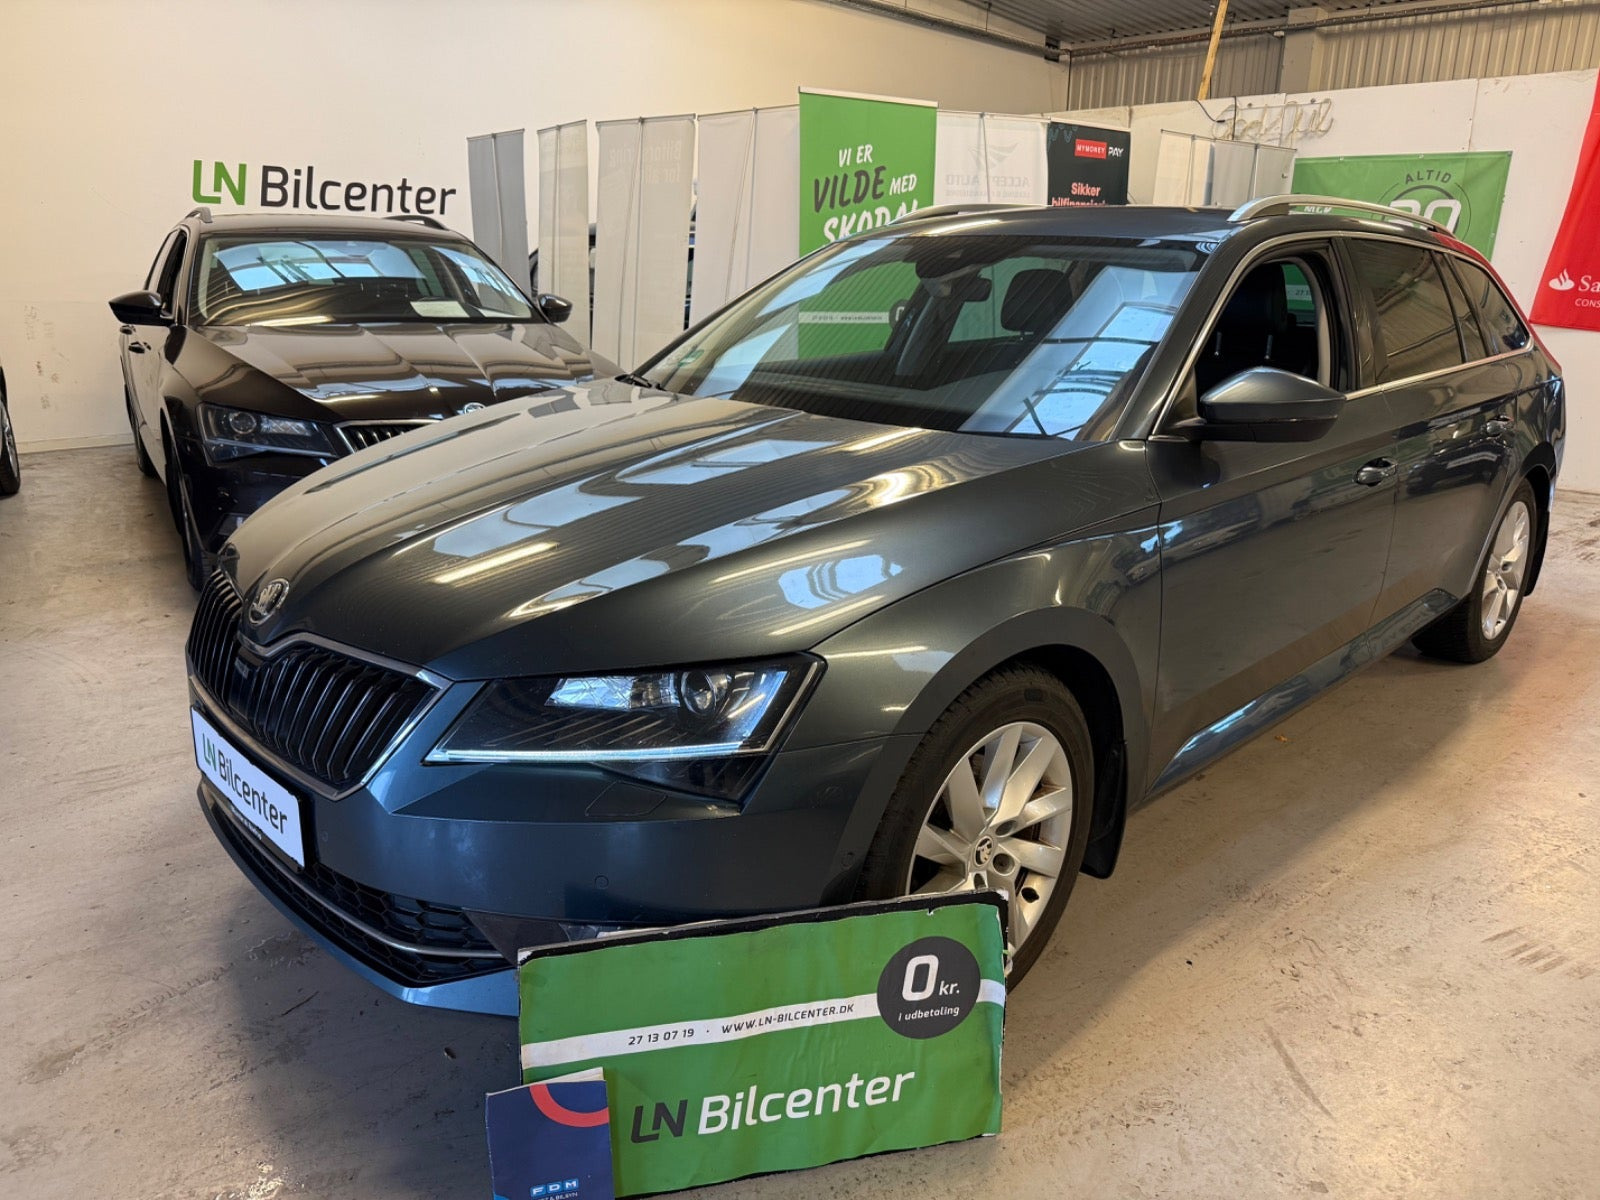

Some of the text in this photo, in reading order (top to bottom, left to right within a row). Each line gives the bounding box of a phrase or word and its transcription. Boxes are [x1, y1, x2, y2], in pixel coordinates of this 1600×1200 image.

[838, 143, 873, 168] VI ER
[1107, 146, 1125, 158] PAY
[192, 159, 457, 216] LN Bilcenter
[814, 165, 918, 213] VILDE MED
[1071, 181, 1101, 197] Sikker
[1404, 169, 1453, 185] ALTID
[202, 732, 218, 773] LN
[217, 748, 288, 835] Bilcenter
[902, 954, 960, 1001] 0 kr.
[628, 1003, 855, 1046] 27 13 07 19 WWW.LN-BILCENTER.DK
[904, 1006, 960, 1021] udbetaling
[630, 1071, 915, 1144] LN Bilcenter
[532, 1180, 577, 1195] FDM
